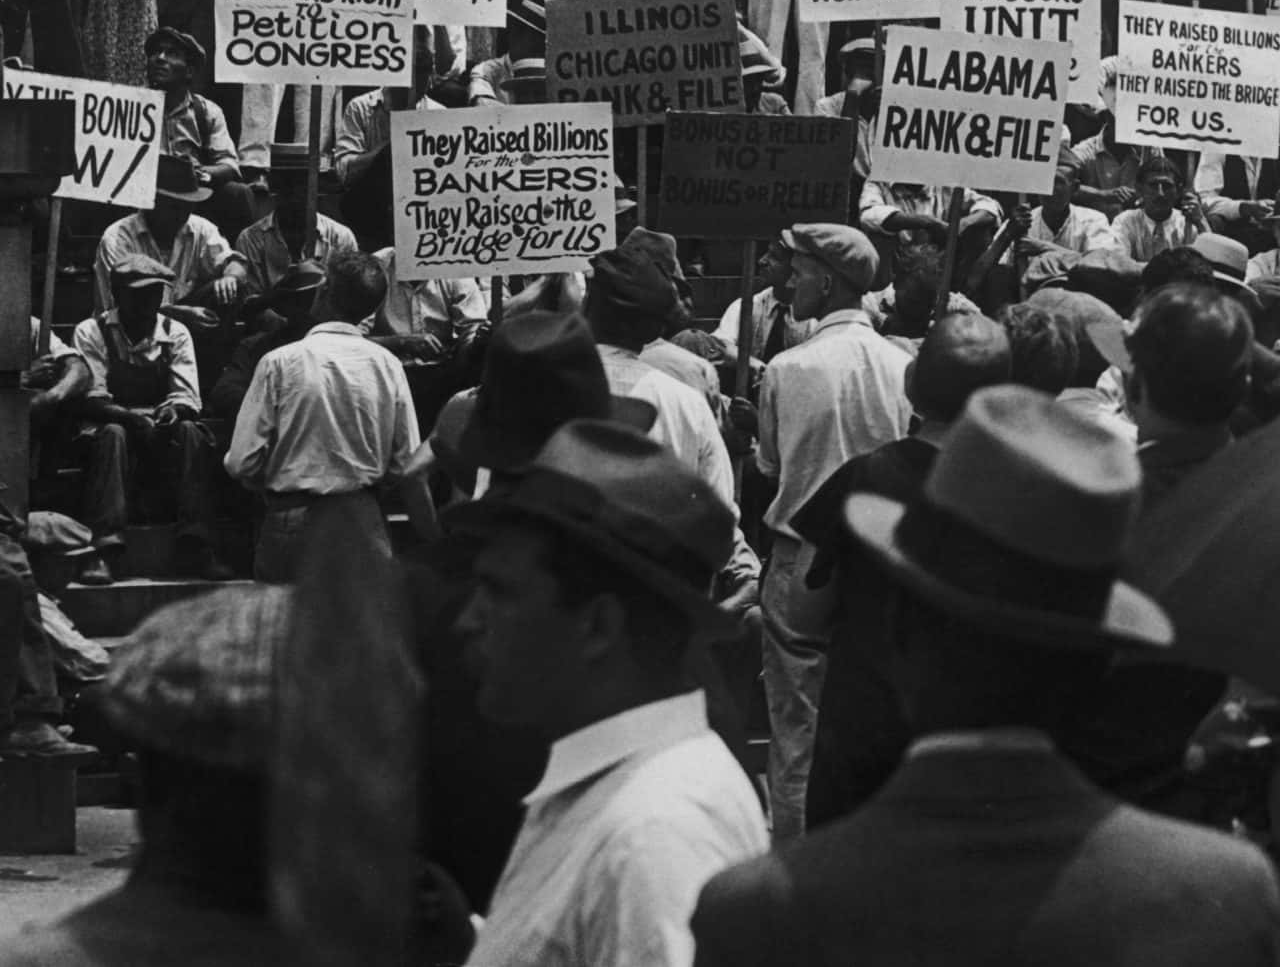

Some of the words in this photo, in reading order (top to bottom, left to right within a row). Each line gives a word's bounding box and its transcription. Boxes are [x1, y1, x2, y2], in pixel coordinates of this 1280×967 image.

[232, 10, 401, 44] Petition
[585, 3, 721, 35] ILLINOIS
[964, 5, 1079, 42] UNIT
[1123, 15, 1164, 36] THEY
[1169, 20, 1218, 43] RAISED
[1223, 26, 1280, 51] BILLIONS
[226, 38, 407, 72] CONGRESS
[556, 44, 677, 80] CHICAGO
[683, 41, 736, 72] UNIT
[892, 45, 1057, 101] ALABAMA
[1152, 48, 1242, 77] BANKERS
[678, 76, 740, 109] FILE
[1119, 74, 1150, 94] THEY
[1154, 76, 1208, 98] RAISED
[1211, 81, 1231, 100] THE
[1235, 84, 1280, 107] BRIDGE
[82, 93, 157, 143] BONUS
[1138, 104, 1180, 127] FOR
[405, 129, 462, 166] They
[462, 125, 530, 155] Raised
[533, 122, 608, 153] Billions
[883, 105, 967, 154] RANK
[994, 115, 1055, 163] FILE
[715, 146, 787, 171] NOT
[405, 200, 462, 234] They
[465, 194, 543, 230] Raised
[551, 193, 596, 222] the
[414, 228, 513, 264] Bridge
[516, 226, 563, 256] for
[562, 222, 607, 253] US
